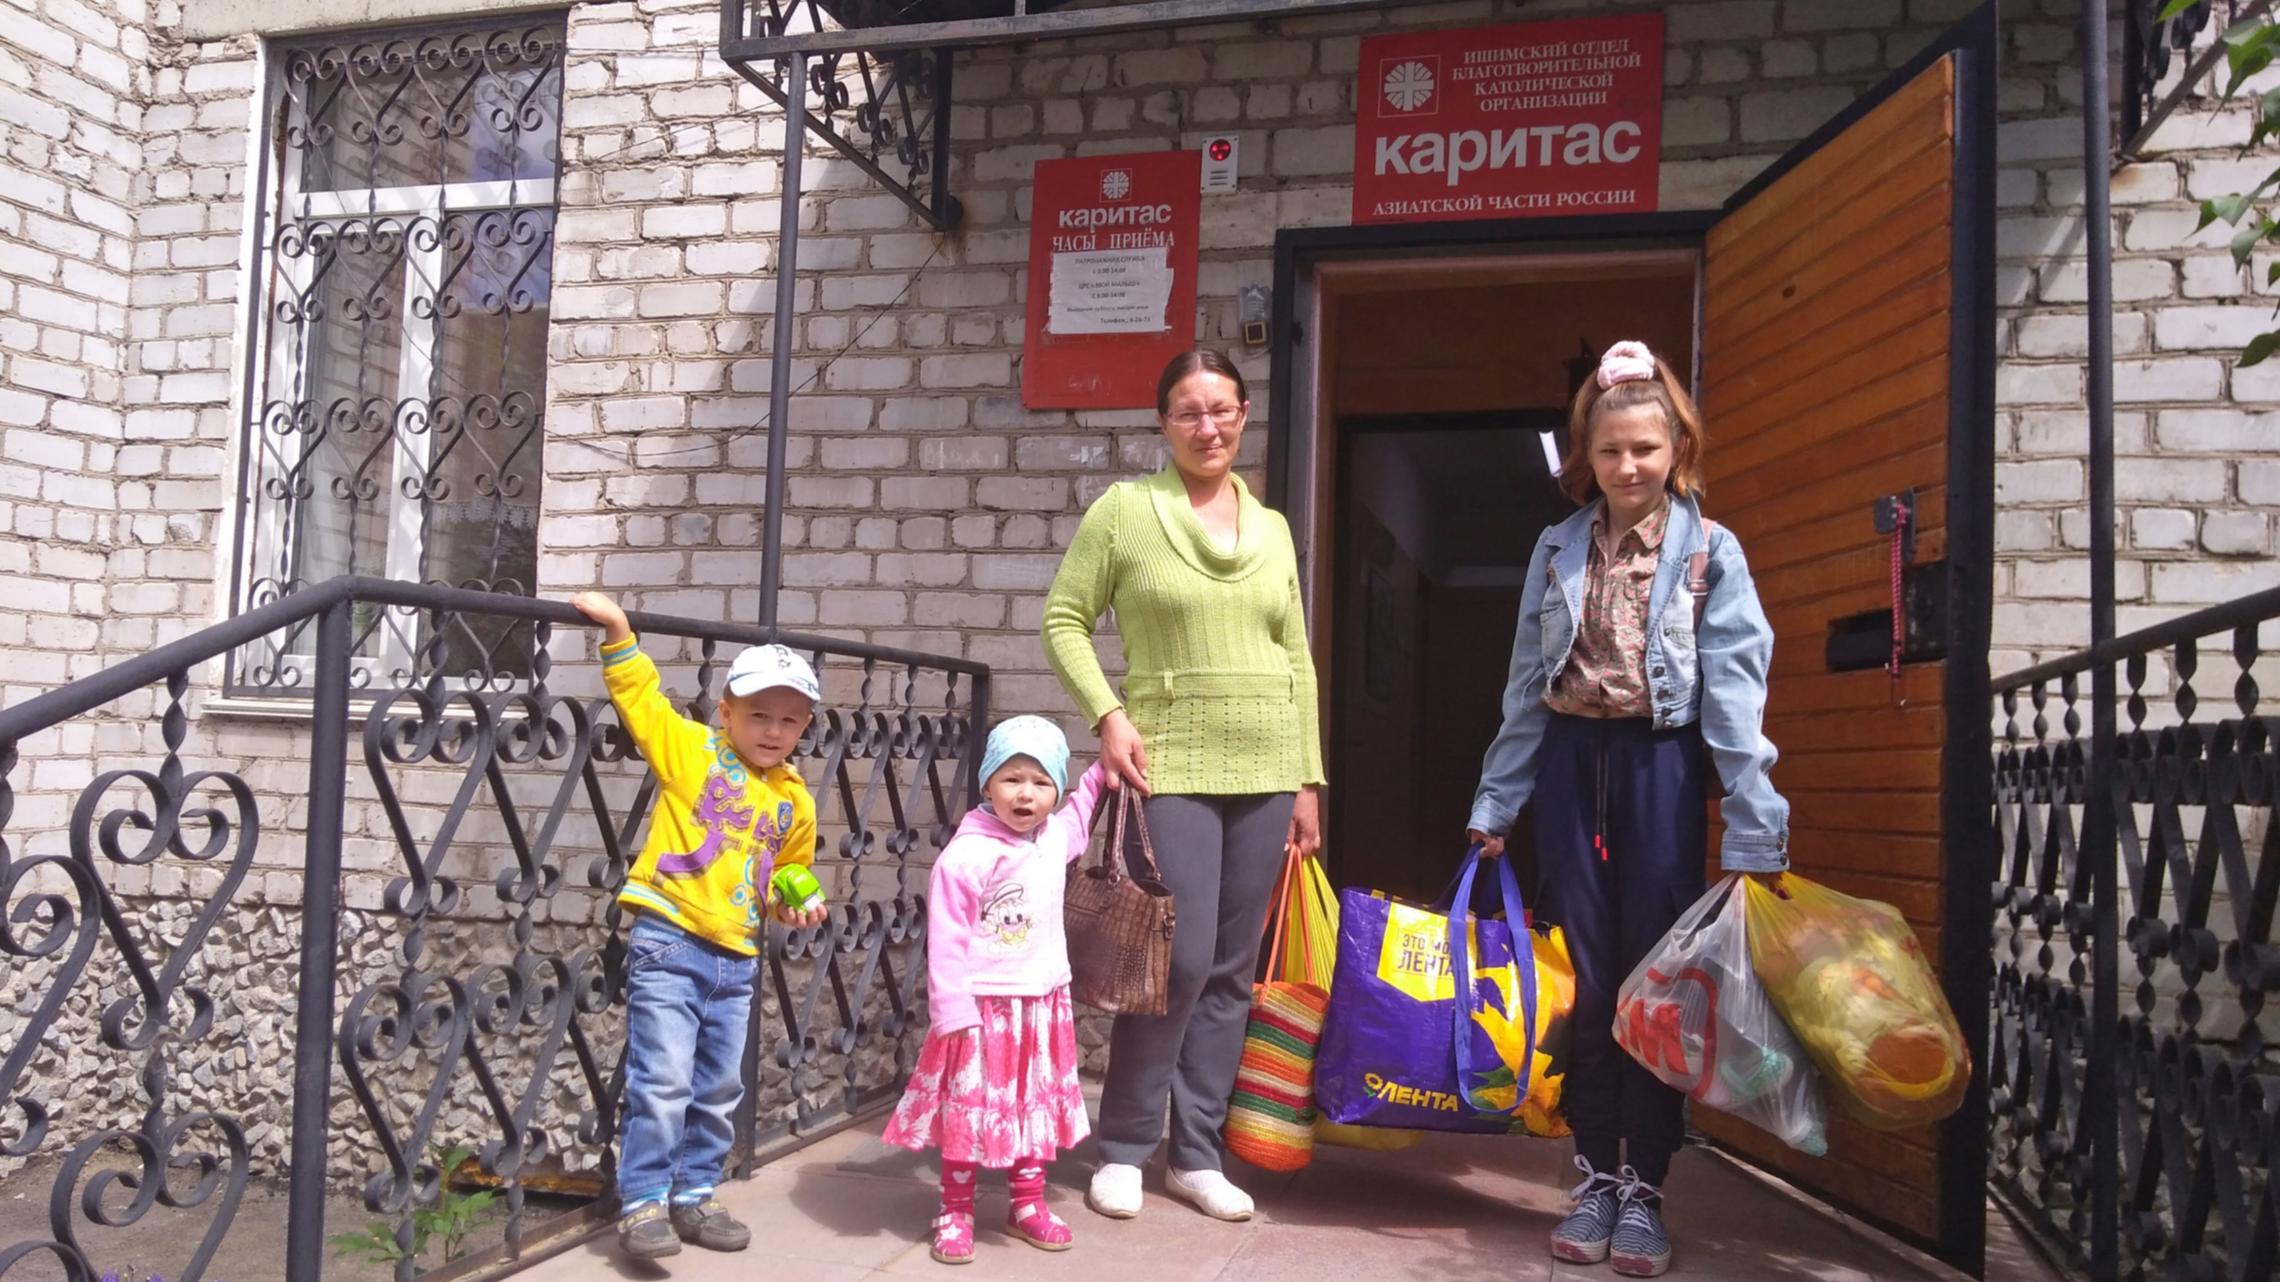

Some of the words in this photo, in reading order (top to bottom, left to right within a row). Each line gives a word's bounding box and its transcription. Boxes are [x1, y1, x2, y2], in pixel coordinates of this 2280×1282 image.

[1464, 42, 1568, 64] ИШИМСКИЙ
[1572, 39, 1629, 56] ОТДЕЛ
[1452, 53, 1641, 81] БЛАГОТВОРИТЕЛЬНОЙ
[1475, 73, 1614, 96] КАТОЛИЧЕСКОЙ
[1480, 91, 1608, 112] ОРГАНИЗАЦИИ
[1374, 121, 1642, 187] каритас
[1372, 194, 1483, 216] АЗИАТСКОЙ
[1488, 193, 1551, 210] ЧАСТИ
[1557, 190, 1636, 207] РОССИИ
[1058, 203, 1172, 233] каритас
[1052, 235, 1097, 252] ЧАСЫ
[1110, 227, 1175, 249] ПРИЁМА
[1402, 933, 1426, 950] ЭТО
[1432, 939, 1450, 955] МО
[1377, 1081, 1458, 1112] ЛЕНТА
